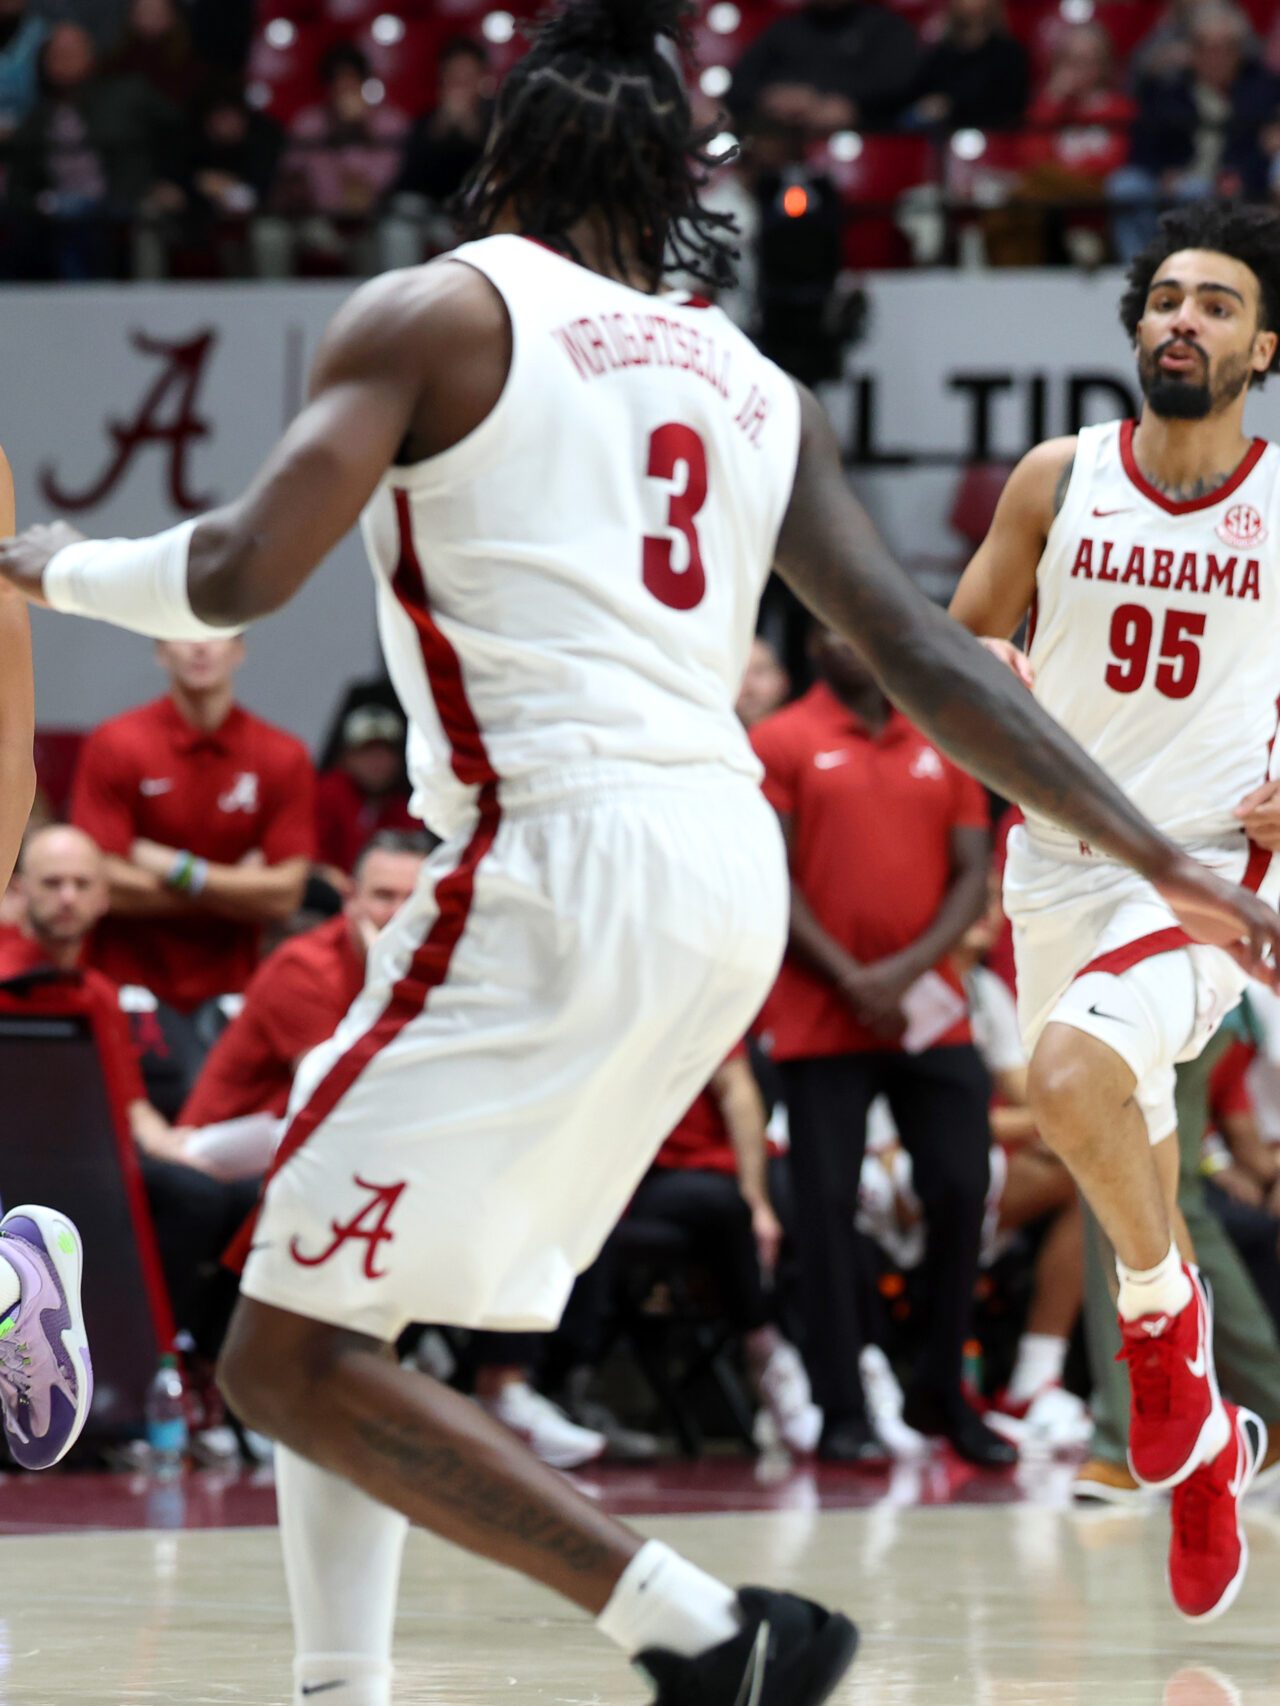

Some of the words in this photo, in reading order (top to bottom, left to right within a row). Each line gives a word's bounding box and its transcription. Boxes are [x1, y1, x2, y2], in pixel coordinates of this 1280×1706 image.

[948, 371, 1138, 463] TID
[643, 422, 707, 611] 3
[1071, 538, 1260, 601] ALABAMA
[1105, 603, 1207, 699] 95
